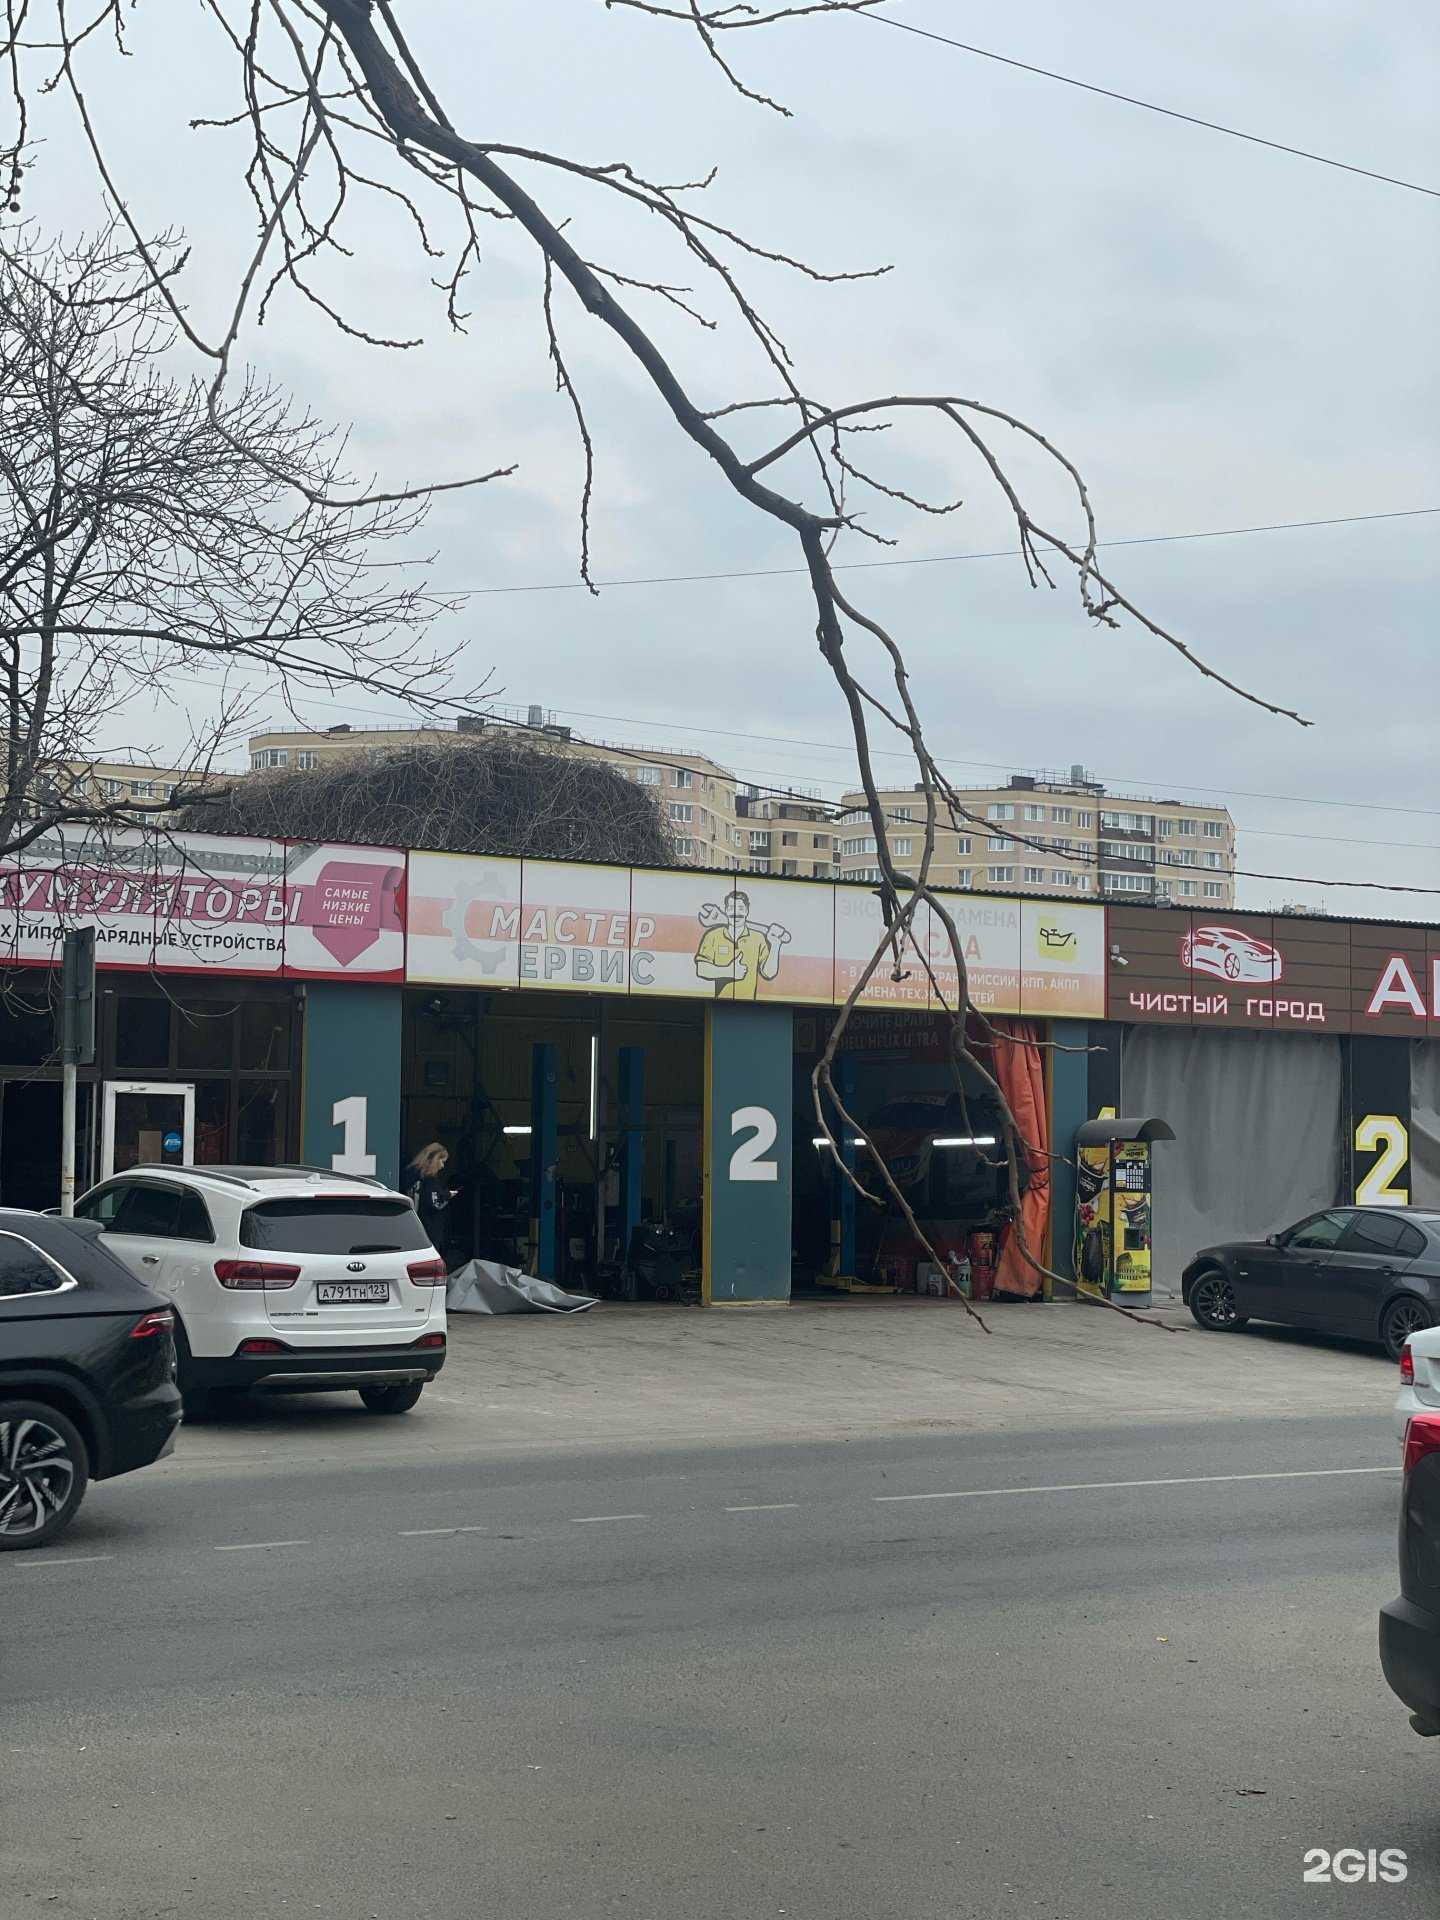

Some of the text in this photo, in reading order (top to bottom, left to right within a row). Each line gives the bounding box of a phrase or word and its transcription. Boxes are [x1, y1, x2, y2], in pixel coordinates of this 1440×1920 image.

[0, 871, 303, 924] УМУЛЯТОРЫ
[322, 900, 371, 913] НИЗКИЕ
[324, 887, 369, 900] САМЫЕ
[328, 912, 364, 926] ЦЕНЫ
[489, 906, 656, 948] МАСТЕР
[18, 925, 73, 940] ТИПО
[96, 929, 177, 946] АРЯДНЫЕ
[183, 933, 287, 953] УСТРОЙСТВА
[519, 944, 656, 985] ЕРВИС
[934, 970, 1018, 987] ТРАНМИССИИ,
[1050, 977, 1080, 991] АКПП
[848, 984, 896, 999] ЗМЕНА
[1366, 956, 1440, 1017] А
[1129, 992, 1325, 1022] ЧИСТЫЙ ГОРОД
[332, 1096, 376, 1177] 1
[729, 1106, 778, 1181] 2
[1355, 1114, 1409, 1206] 2
